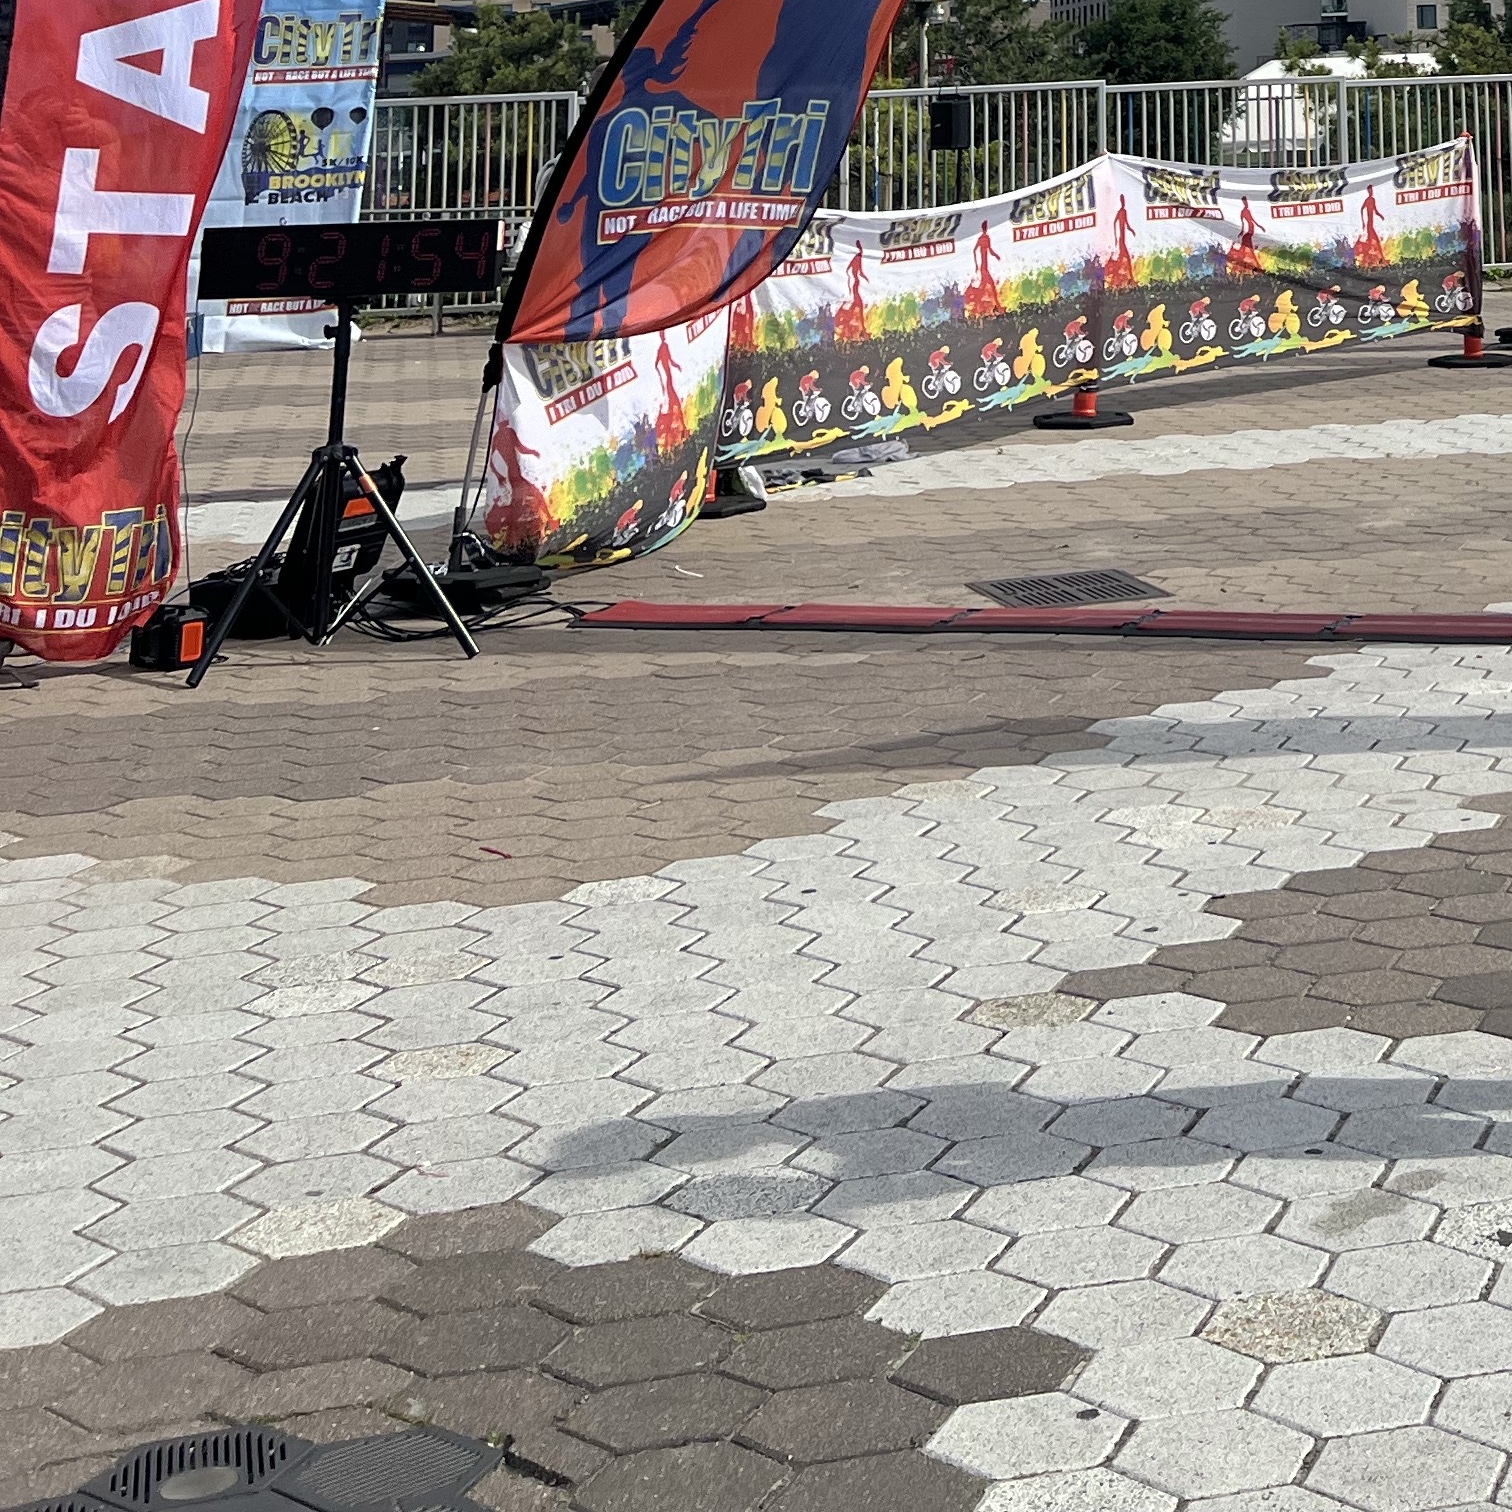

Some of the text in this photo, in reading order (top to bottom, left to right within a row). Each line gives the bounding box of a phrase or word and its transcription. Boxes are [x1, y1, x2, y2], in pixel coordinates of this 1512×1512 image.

[598, 98, 830, 206] CityTri
[268, 170, 366, 190] BROOKLYN
[268, 190, 328, 205] BEACH
[604, 214, 637, 235] NOT
[715, 201, 727, 218] A
[729, 201, 757, 220] LIFE
[1021, 226, 1040, 240] TRI
[1048, 221, 1065, 234] DU
[1074, 215, 1094, 229] DID
[229, 303, 249, 314] NOT
[586, 381, 603, 401] DU
[0, 504, 173, 604] ityTri
[53, 607, 97, 629] DU
